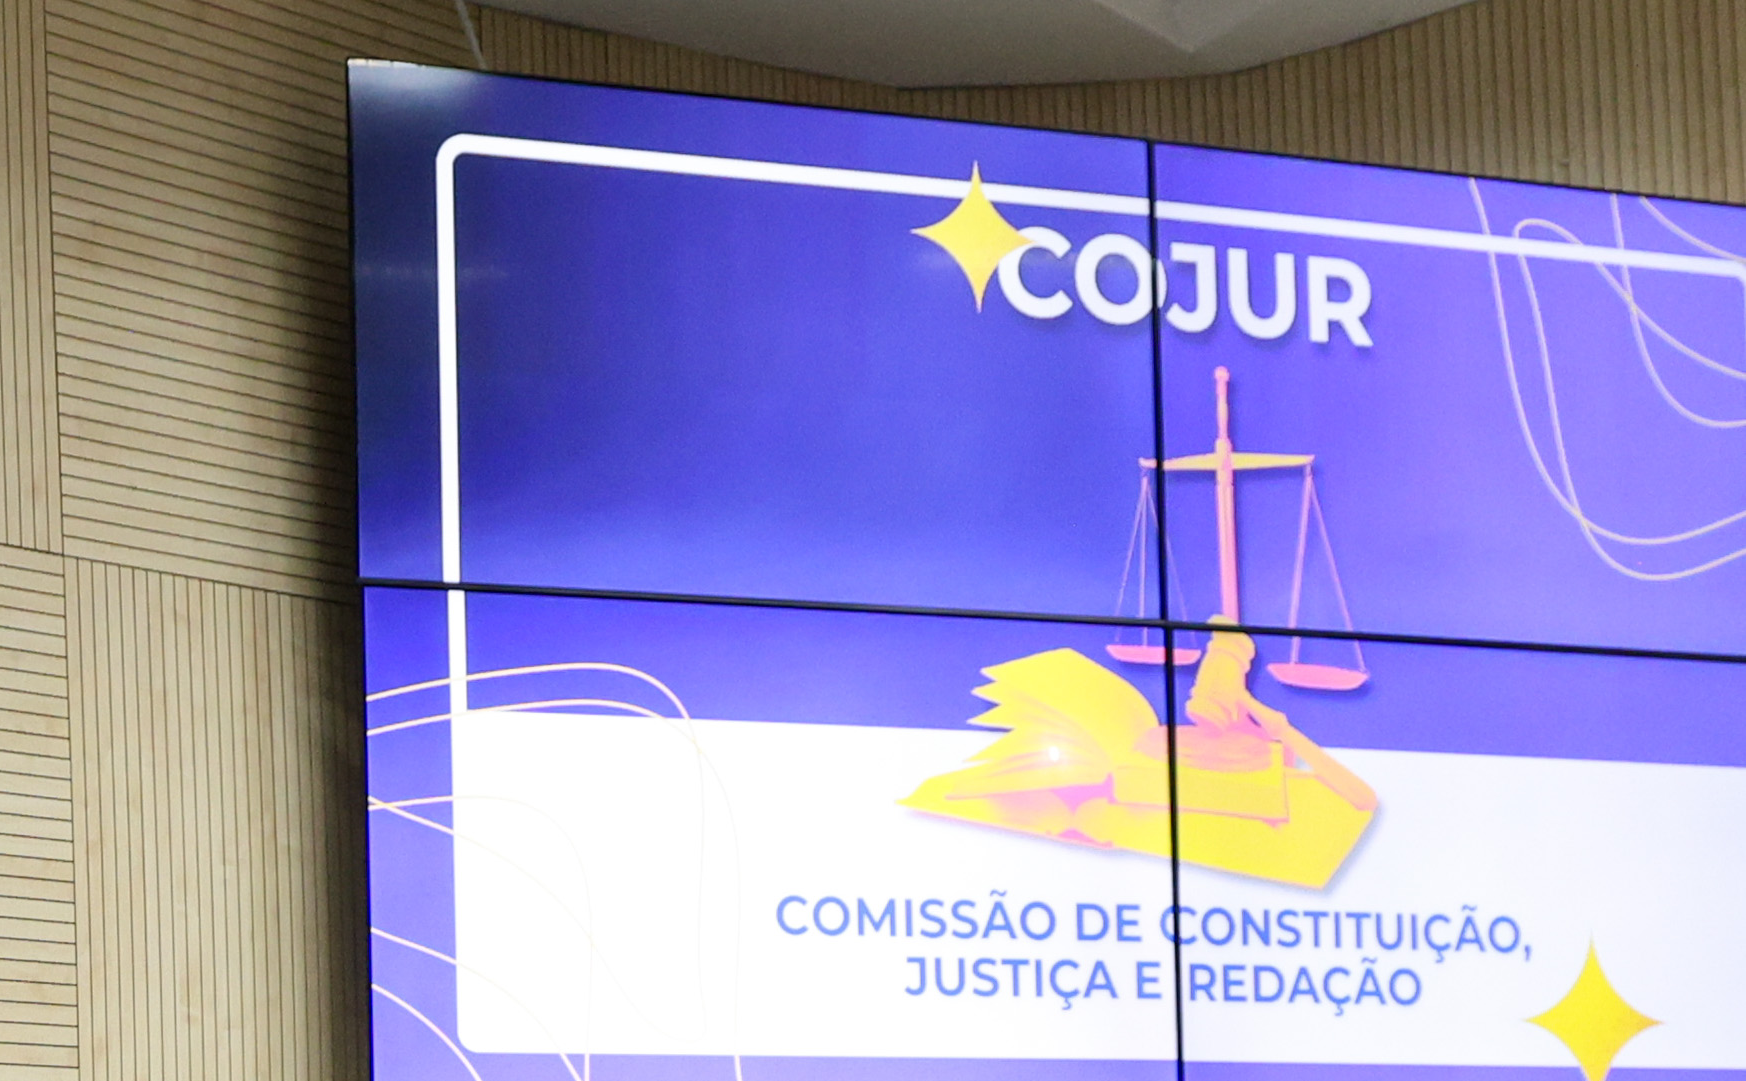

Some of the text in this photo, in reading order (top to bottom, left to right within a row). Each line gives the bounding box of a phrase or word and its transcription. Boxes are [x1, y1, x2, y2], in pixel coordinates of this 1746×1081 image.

[998, 226, 1374, 347] COJUR
[775, 890, 1534, 964] COMISSÃO DE CONSTITUIÇÃO,
[905, 956, 1423, 1015] JUSTIÇA E REDAÇÃO
